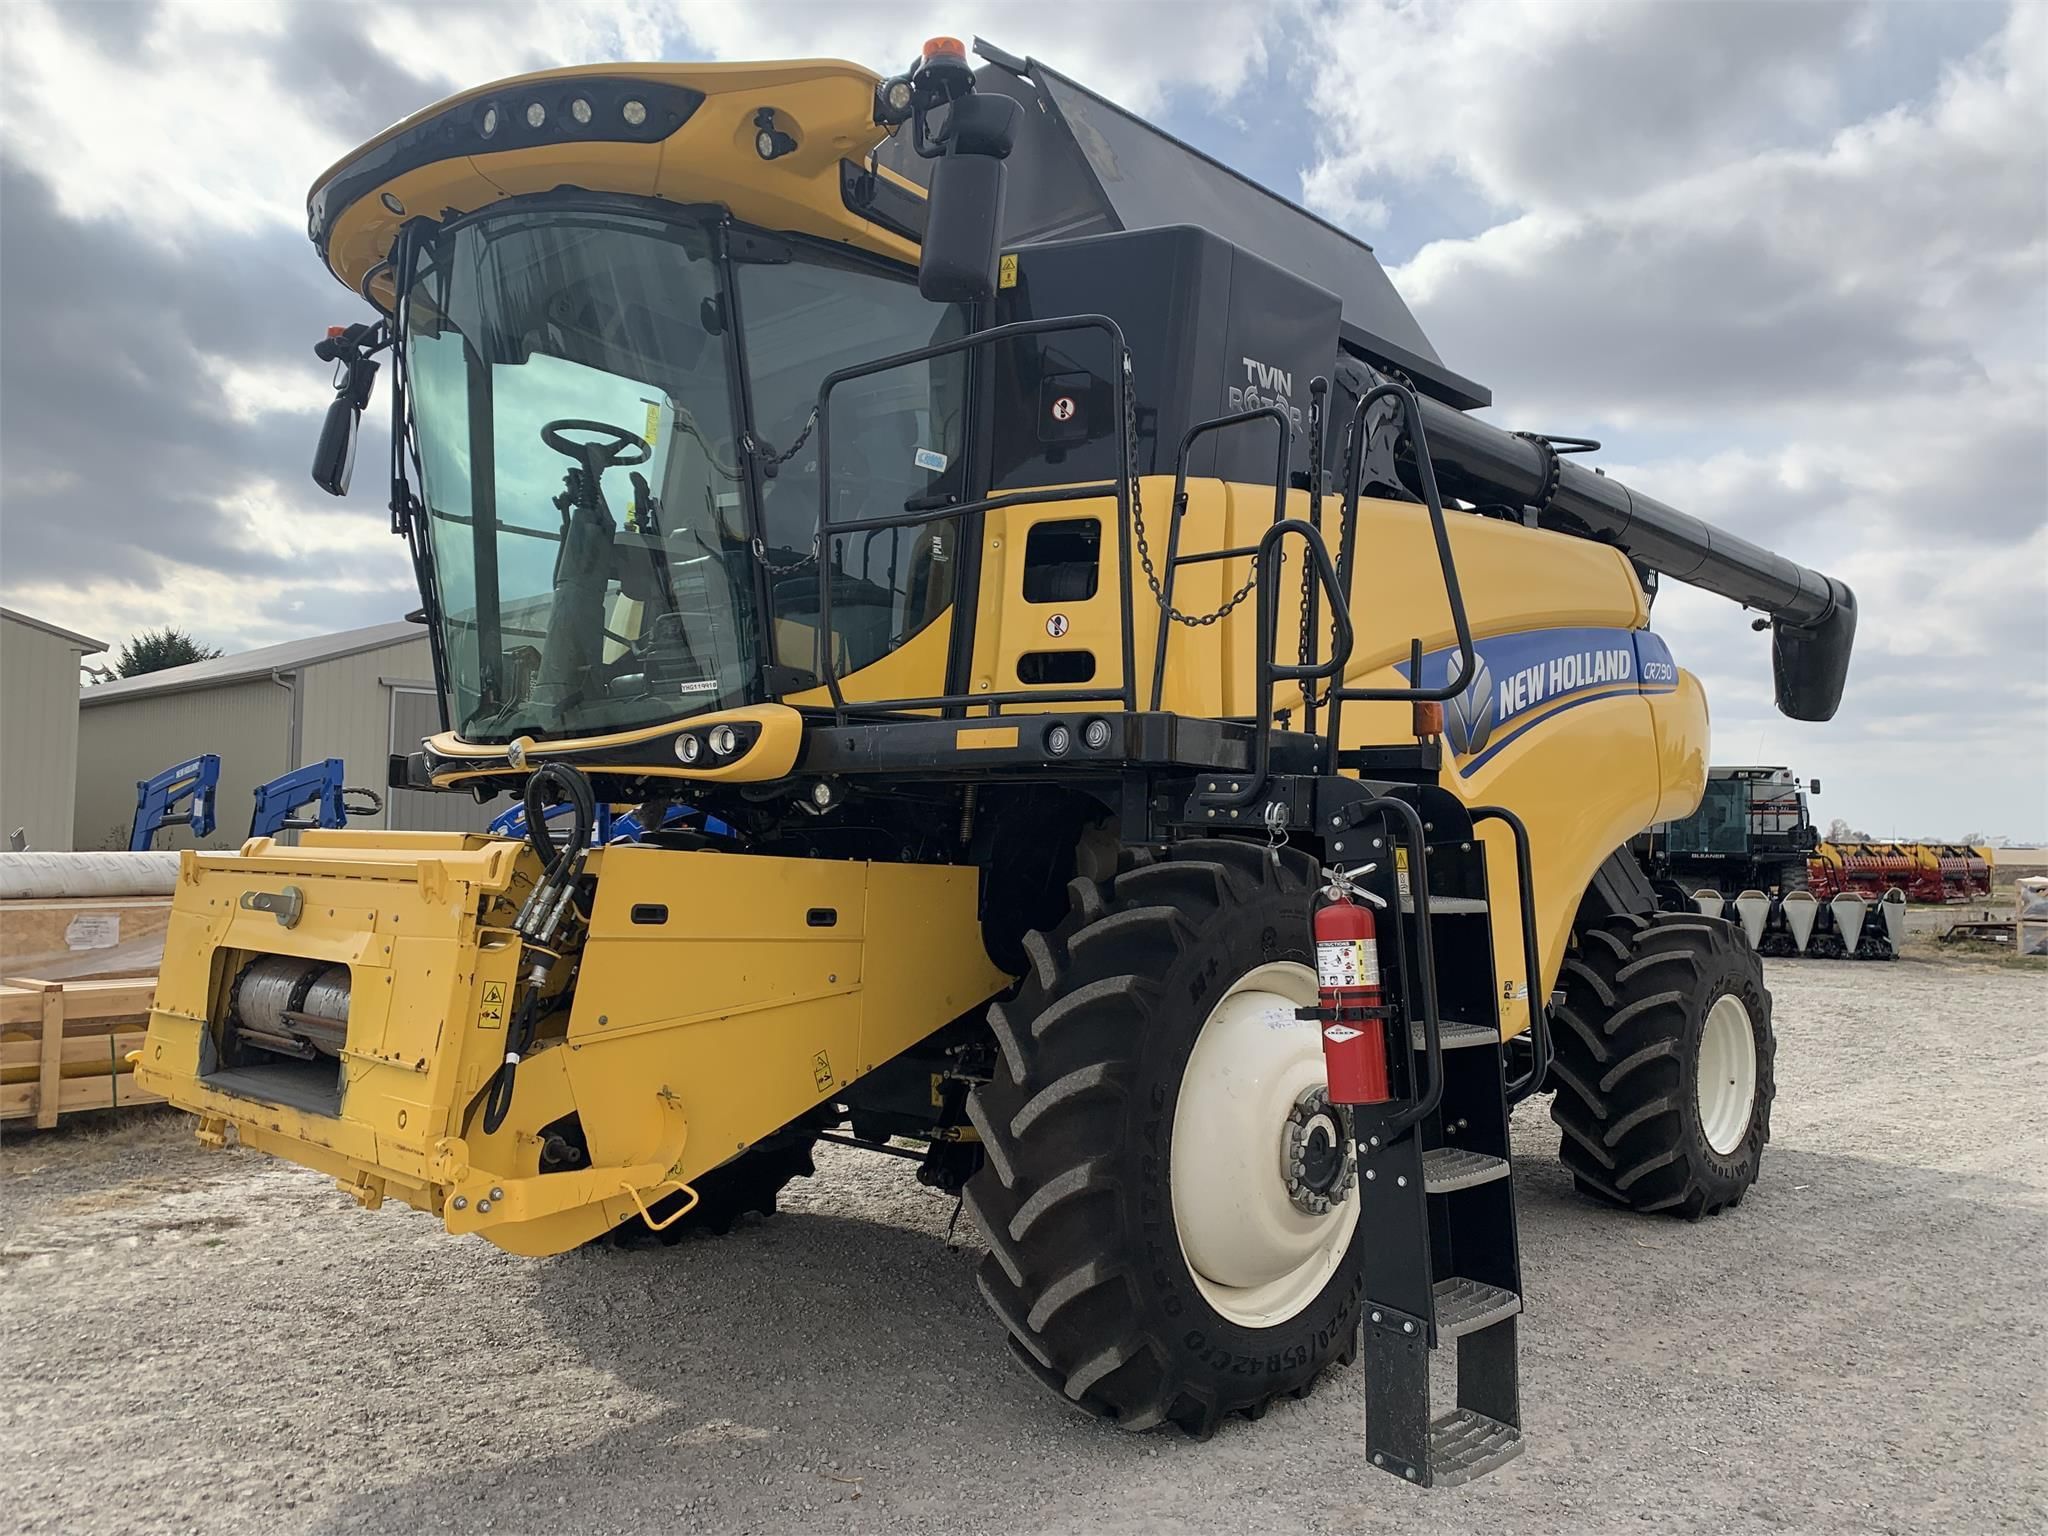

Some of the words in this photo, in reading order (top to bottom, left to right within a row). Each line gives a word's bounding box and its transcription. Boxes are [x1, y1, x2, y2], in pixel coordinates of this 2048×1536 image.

[1242, 357, 1292, 397] TWIN
[1499, 662, 1545, 721] NEW
[1549, 649, 1631, 696] HOLLAND
[1643, 662, 1673, 681] CR7.90
